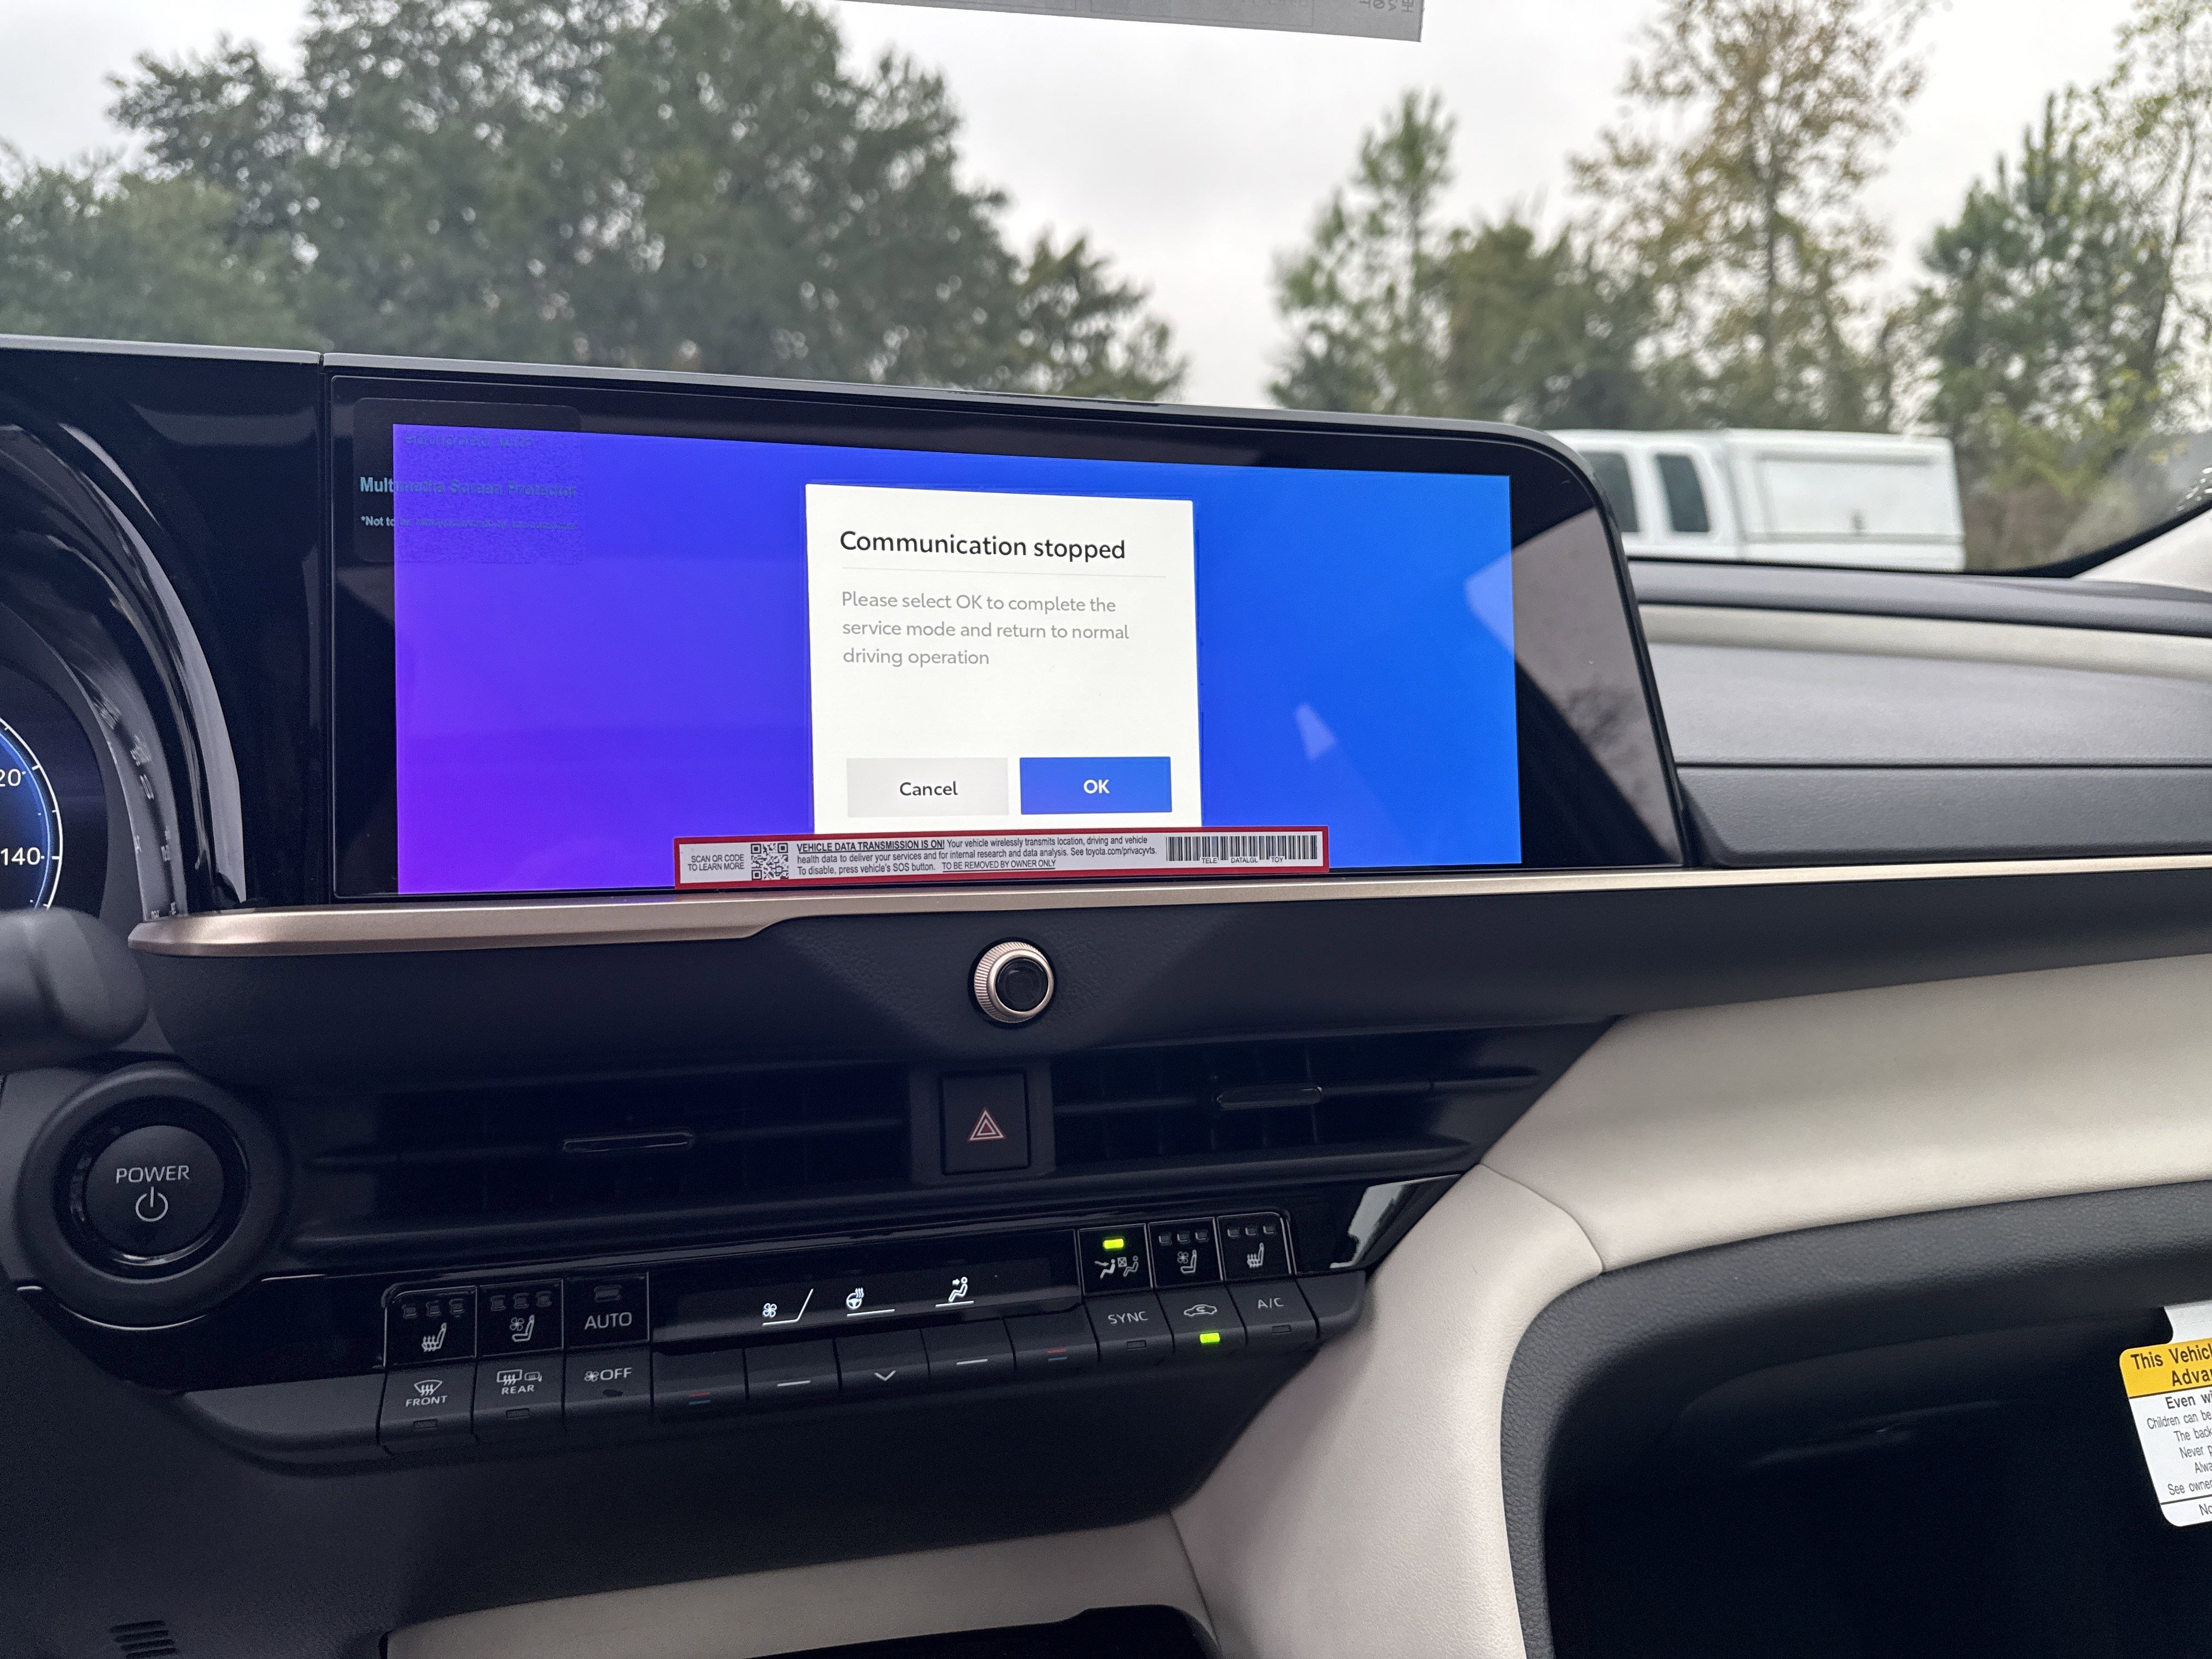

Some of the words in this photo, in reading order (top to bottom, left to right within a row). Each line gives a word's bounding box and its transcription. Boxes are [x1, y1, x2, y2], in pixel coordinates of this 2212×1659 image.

[449, 480, 503, 496] Screen
[507, 481, 576, 499] Protector
[386, 517, 396, 527] to
[840, 531, 1026, 556] Communication
[1034, 538, 1126, 562] stopped
[842, 591, 898, 608] Please
[902, 593, 952, 609] select
[956, 594, 983, 610] OK
[986, 596, 1005, 610] to
[1008, 596, 1086, 614] complete
[1090, 597, 1116, 612] the
[842, 621, 901, 636] service
[906, 622, 956, 637] mode
[960, 622, 992, 637] and
[996, 624, 1046, 638] return
[1051, 624, 1068, 639] to
[1072, 624, 1129, 640] normal
[843, 648, 902, 667] driving
[908, 650, 990, 668] operation
[899, 781, 958, 797] Cancel
[1084, 779, 1110, 794] OK
[797, 843, 833, 851] VEHICLE
[834, 842, 856, 851] DATA
[857, 840, 920, 850] TRANSMISSION
[921, 840, 929, 849] IS
[931, 839, 945, 849] ON!
[947, 839, 963, 848] Your
[964, 838, 989, 848] vehicle
[990, 837, 1023, 849] wirelessly
[1025, 837, 1056, 846] transmits
[1057, 836, 1085, 846] location,
[1087, 836, 1109, 847] driving
[1110, 836, 1123, 844] and
[1125, 836, 1148, 844] vehicle
[1, 847, 41, 866] 140
[797, 855, 820, 864] health
[821, 854, 838, 863] data
[840, 854, 847, 862] to
[850, 853, 873, 862] deliver
[874, 854, 890, 864] your
[893, 852, 922, 861] services
[924, 851, 937, 860] and
[939, 850, 948, 859] for
[950, 850, 975, 859] internal
[977, 849, 1007, 858] research
[1008, 849, 1021, 857] and
[1023, 848, 1038, 857] data
[1040, 848, 1069, 858] analysis.
[1071, 847, 1084, 856] See
[1086, 846, 1157, 857] toyota.com/privacyvts.
[699, 862, 723, 871] LEARN
[724, 862, 745, 870] MORE
[798, 866, 806, 875] To
[808, 865, 837, 875] disable,
[839, 866, 859, 876] press
[860, 863, 891, 873] vehicle's
[893, 862, 910, 872] SOS
[911, 862, 935, 871] button.
[942, 862, 952, 870] TO
[953, 861, 963, 870] BE
[964, 860, 999, 869] REMOVED
[1000, 860, 1010, 868] BY
[1011, 859, 1037, 868] OWNER
[116, 1165, 190, 1183] POWER
[1257, 1297, 1284, 1310] A/C
[584, 1312, 633, 1330] AUTO
[1107, 1311, 1148, 1325] SYNC
[2130, 1351, 2164, 1370] This
[600, 1367, 633, 1381] OFF
[501, 1384, 535, 1395] REAR
[405, 1395, 448, 1407] FRONT
[2165, 1396, 2196, 1409] Even
[2147, 1415, 2181, 1429] Children
[2183, 1413, 2199, 1424] can
[2199, 1409, 2212, 1421] be
[2173, 1430, 2191, 1442] The
[2179, 1446, 2204, 1459] Never
[2168, 1483, 2185, 1495] See
